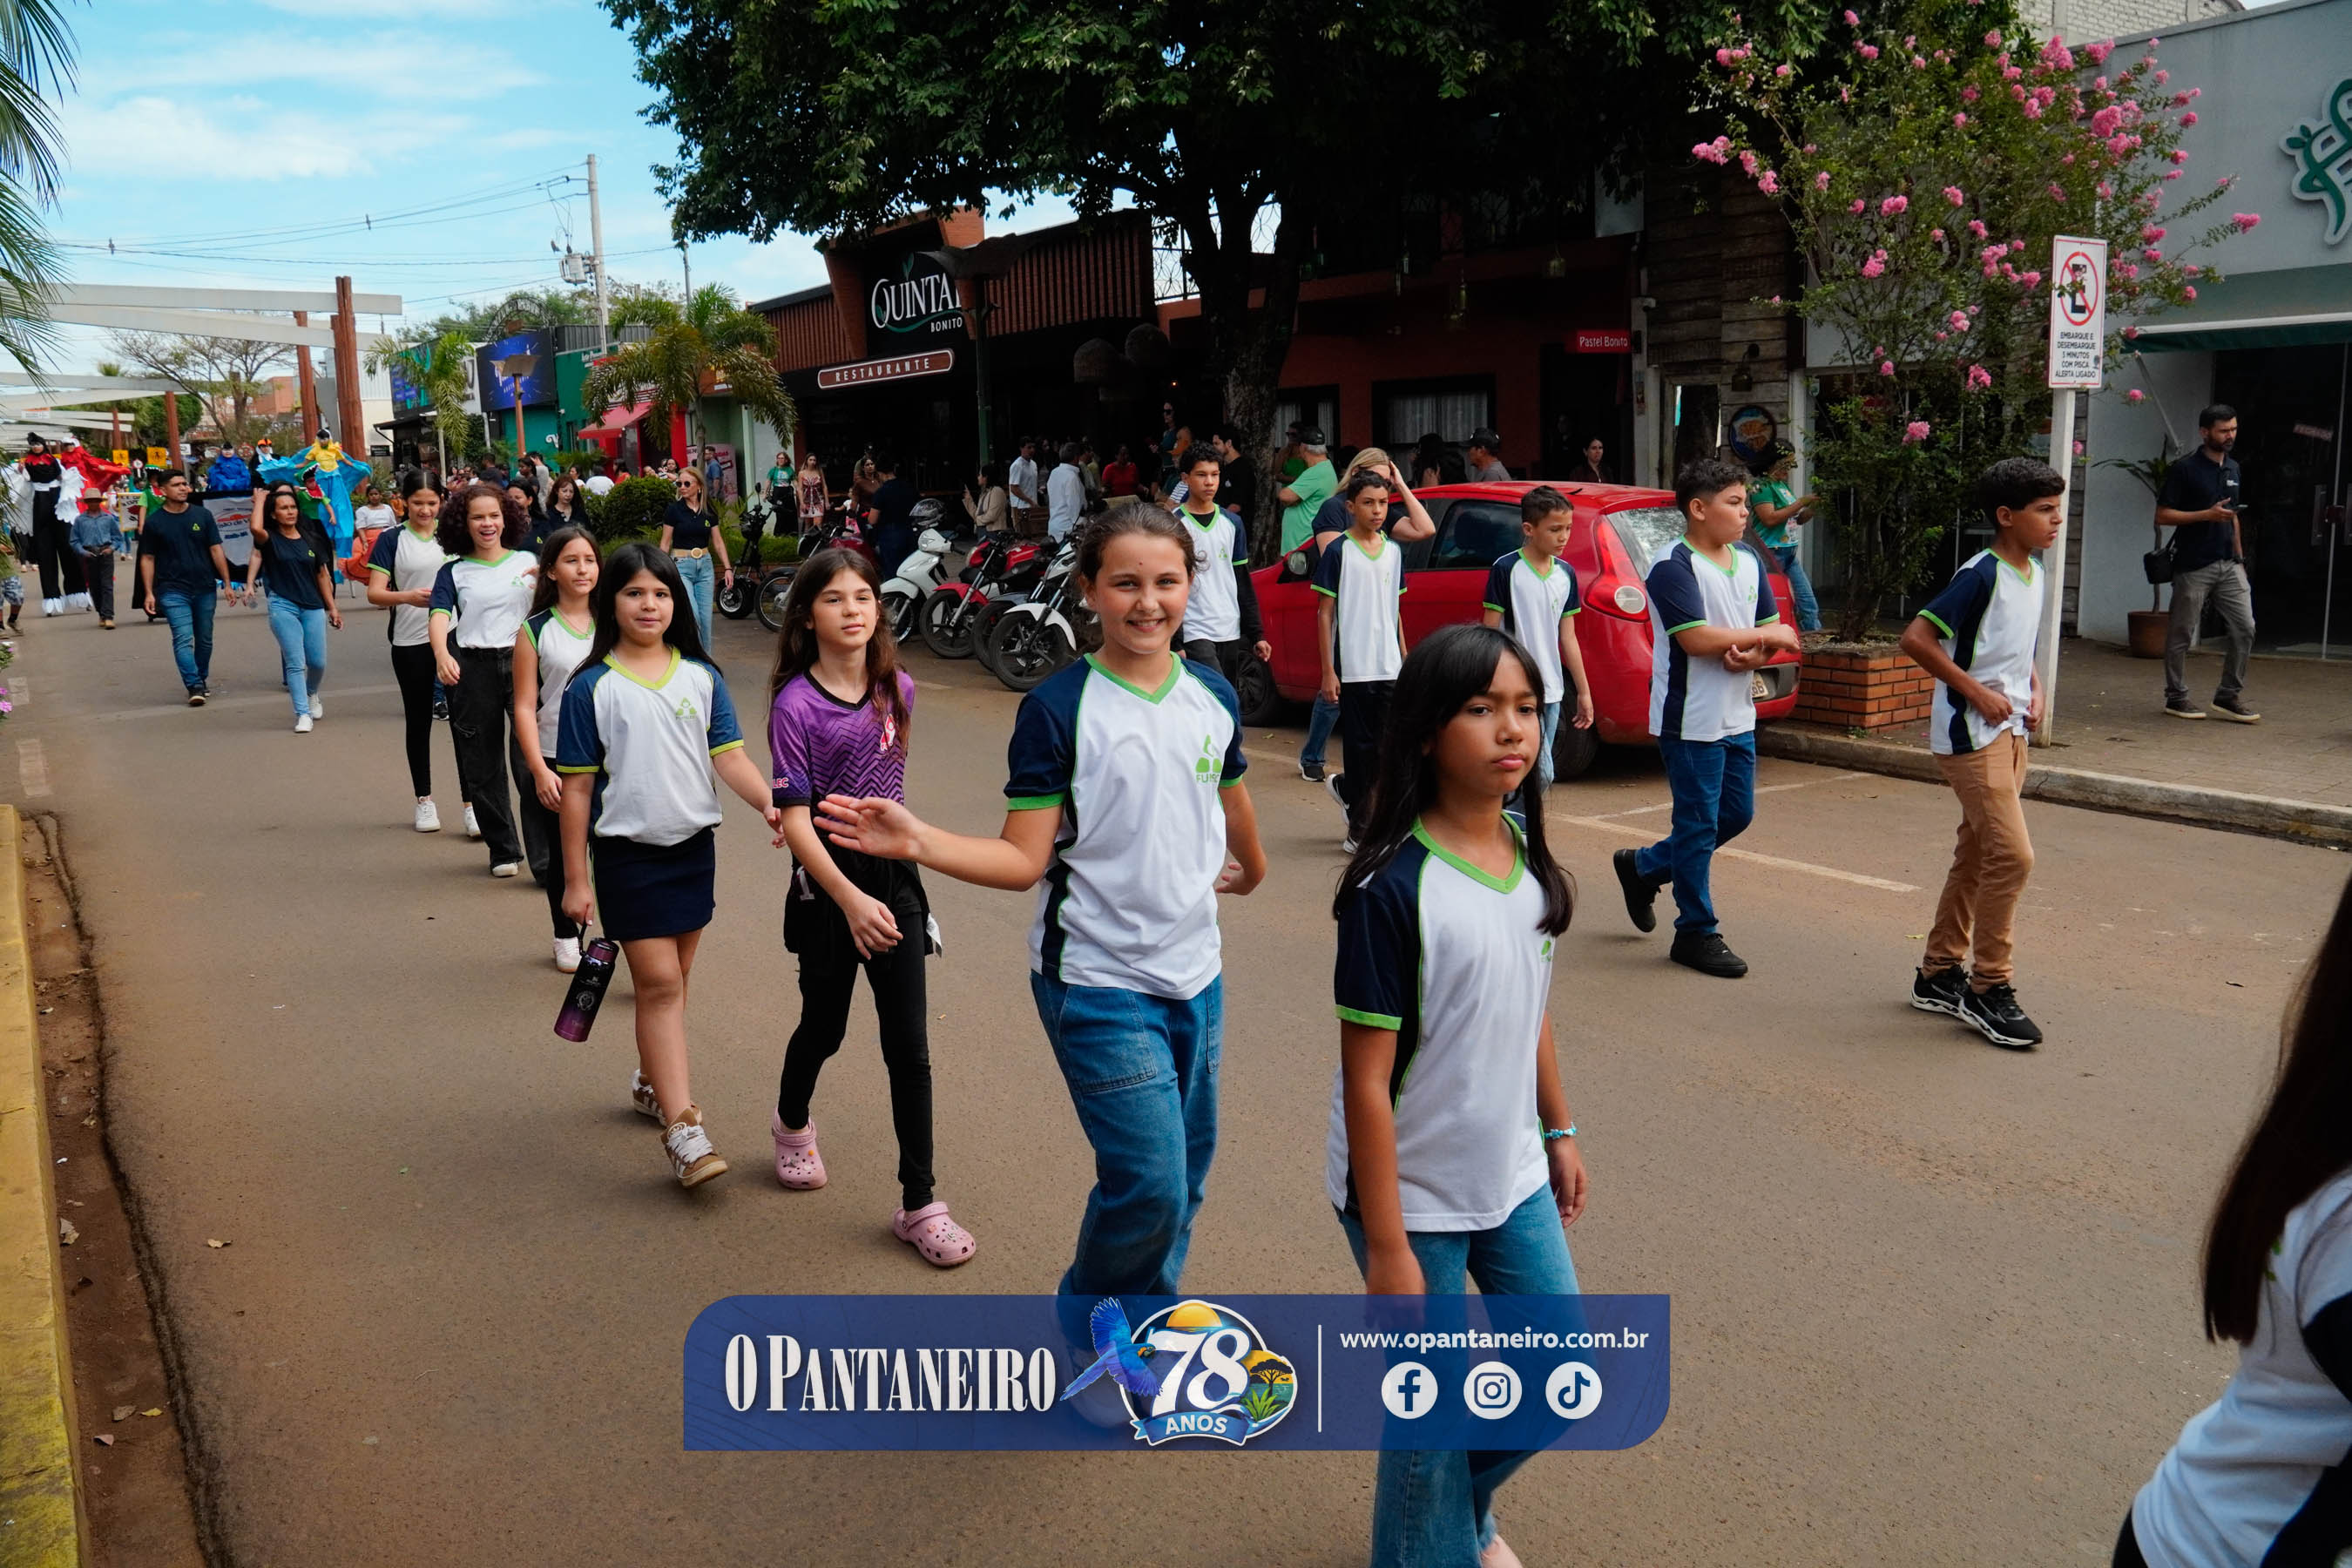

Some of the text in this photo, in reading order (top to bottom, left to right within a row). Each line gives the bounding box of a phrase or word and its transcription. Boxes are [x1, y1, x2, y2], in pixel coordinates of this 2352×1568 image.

[930, 317, 963, 332] BONITO
[1579, 336, 1628, 347] Pastel Bonito
[835, 358, 929, 382] RESTAURANTE
